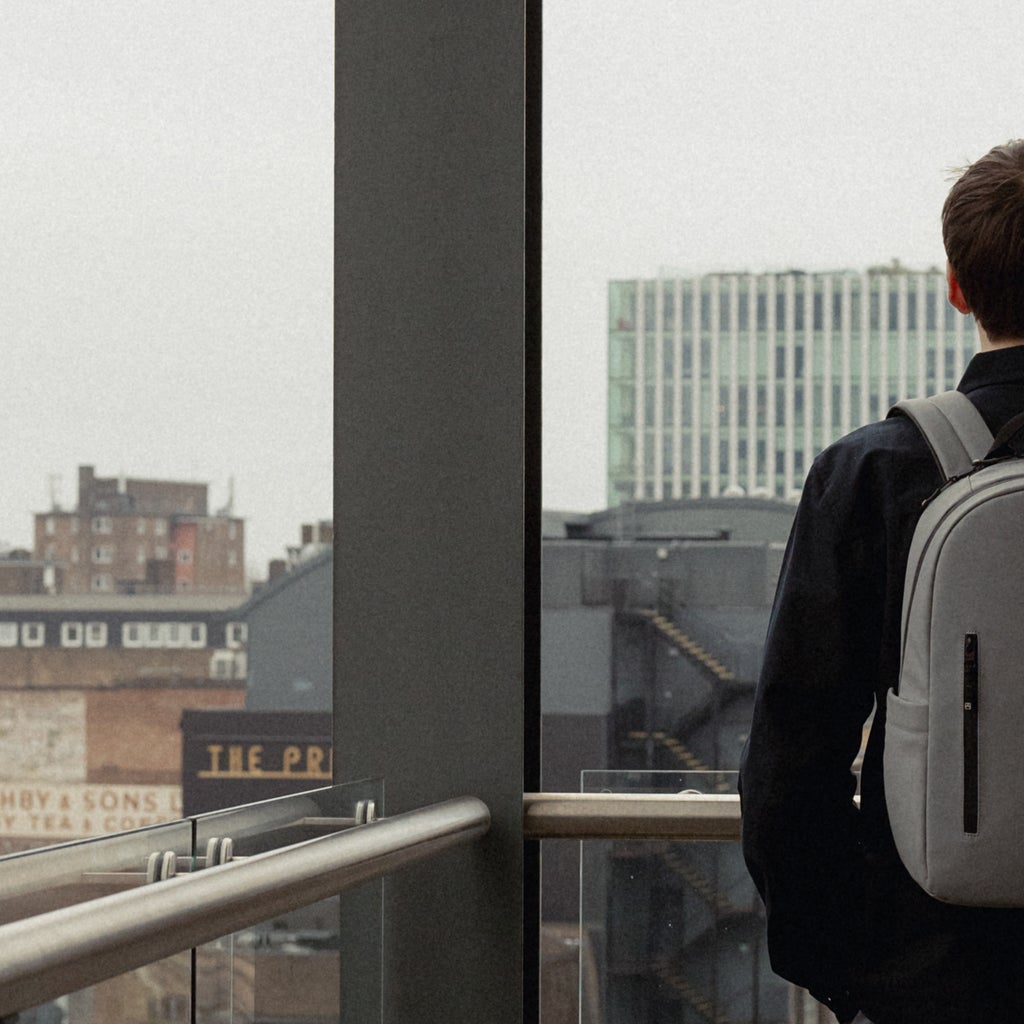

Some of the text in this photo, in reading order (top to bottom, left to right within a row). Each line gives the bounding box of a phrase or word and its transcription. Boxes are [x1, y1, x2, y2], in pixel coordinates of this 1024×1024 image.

[207, 745, 332, 774] THE PR
[83, 790, 158, 812] SONS
[31, 814, 72, 832] TEA
